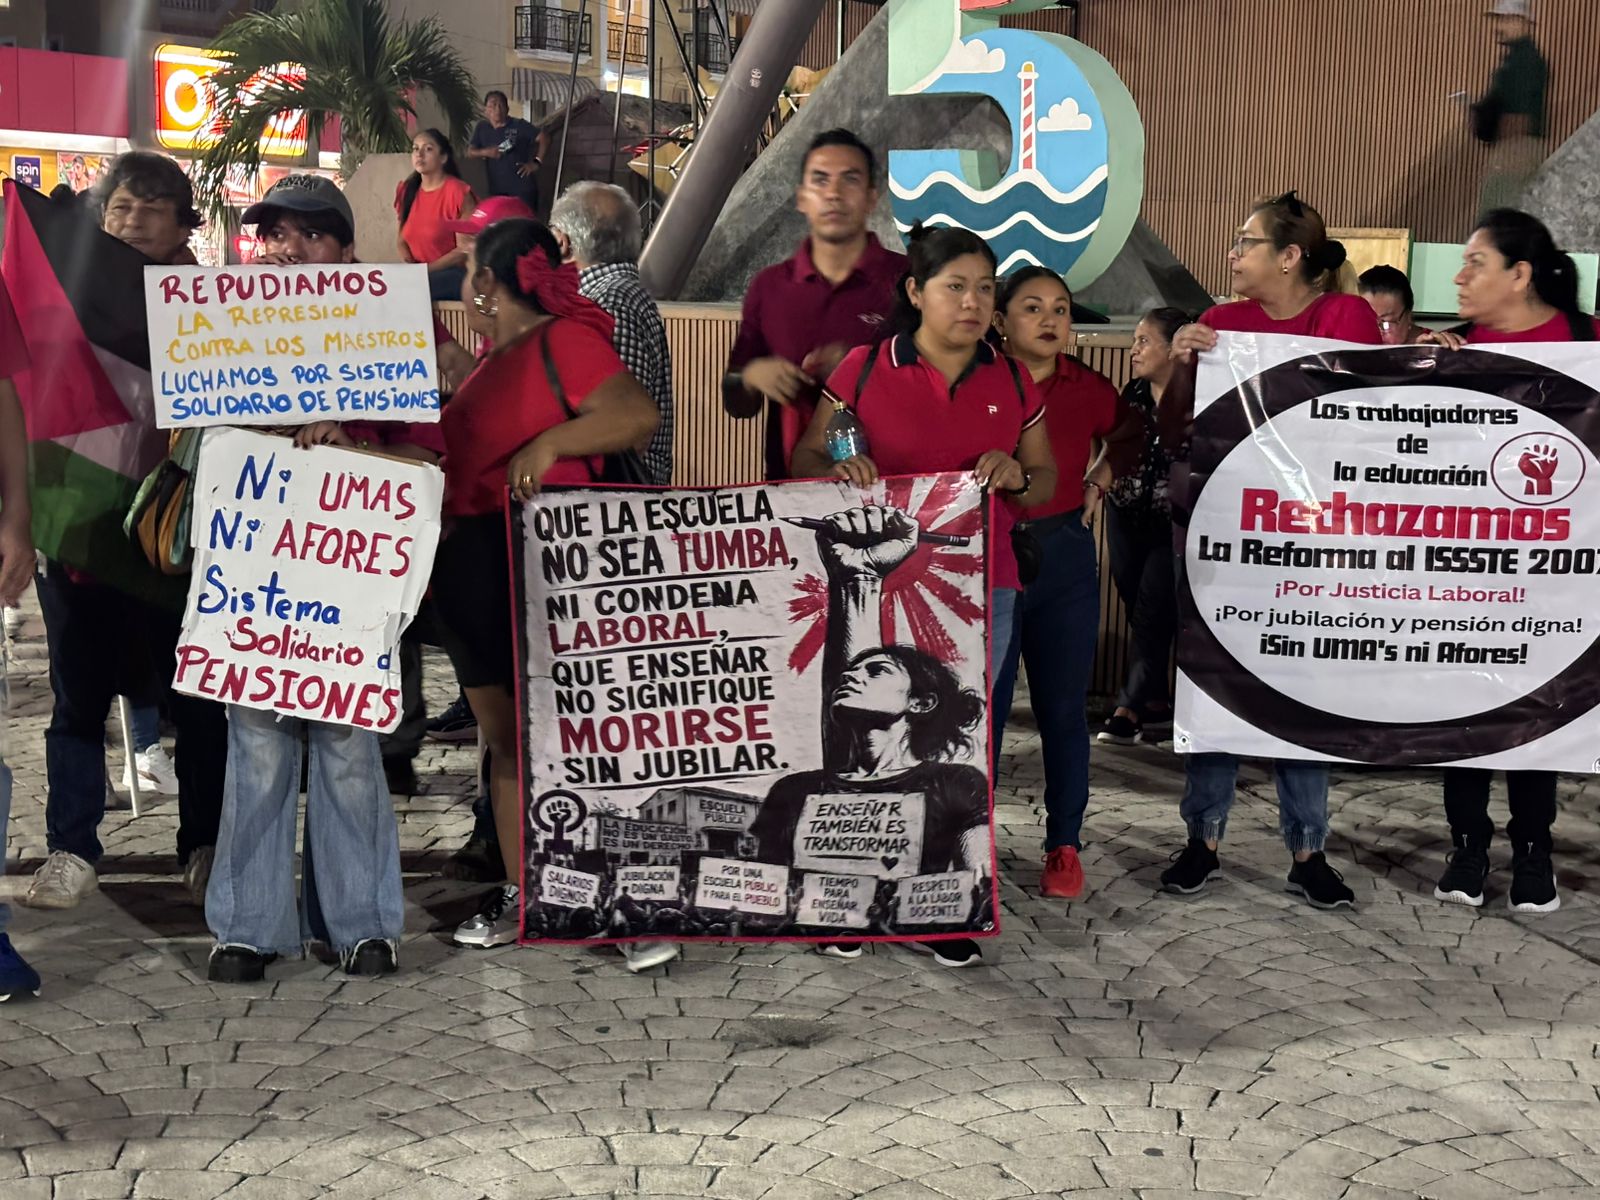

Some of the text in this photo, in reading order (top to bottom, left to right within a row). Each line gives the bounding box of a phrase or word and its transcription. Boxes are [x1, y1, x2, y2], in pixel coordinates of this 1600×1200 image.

[16, 162, 39, 177] spin
[159, 269, 388, 304] REPUDIAMOS
[177, 303, 359, 336] LA REPRESION
[167, 330, 428, 364] CONTRA LOS MAESTROS
[161, 359, 428, 396] LUCHAMOS POR SISTEMA
[171, 392, 293, 420] SOLIDARIO
[298, 390, 331, 413] DE
[1310, 399, 1519, 428] Los trabajadores
[1396, 433, 1428, 454] de
[1333, 461, 1487, 486] la educación
[319, 472, 416, 520] UMAS
[534, 489, 774, 542] QUE LA ESCUELA
[1240, 487, 1571, 541] Rechazamos
[272, 519, 414, 577] AFORES
[541, 526, 799, 584] NO SEA TUMBA,
[1198, 535, 1232, 563] La
[1240, 538, 1376, 570] Reforma
[1386, 545, 1415, 571] al
[1425, 545, 1519, 574] ISSSTE
[197, 564, 341, 625] Sistema
[545, 579, 759, 621] NI CONDENA
[1275, 580, 1526, 603] ¡Por Justicia Laboral!
[549, 611, 729, 654] LABORAL,
[1215, 605, 1582, 637] ¡Por jubilación y pensión digna!
[225, 616, 364, 666] Solidario
[1405, 641, 1430, 663] ni
[1436, 641, 1528, 664] Afores!
[552, 644, 769, 688] QUE ENSEÑAR
[175, 645, 400, 728] PENSIONES
[555, 675, 775, 715] NO SIGNIFIQUE
[559, 704, 773, 755] MORIRSE
[564, 743, 789, 783] SIN JUBILAR.
[700, 799, 746, 814] ESCUELA
[815, 800, 902, 817] ENSEÑAR
[603, 819, 620, 829] LA
[603, 828, 620, 838] NO
[624, 830, 638, 840] ES
[642, 832, 657, 841] UN
[809, 816, 907, 834] TAMBIÉN ES
[603, 838, 691, 850] ES UN DERECHO
[803, 836, 910, 855] TRANSFORMAR
[547, 870, 595, 891] SALARIOS
[703, 876, 741, 889] ESCUELA
[721, 865, 763, 879] POR UNA
[818, 876, 859, 889] TIEMPO
[911, 878, 960, 892] RESPETO
[703, 890, 709, 898] Y
[710, 890, 730, 900] PARA
[732, 892, 742, 901] EL
[823, 888, 850, 899] PARA
[907, 892, 963, 905] A LA LABOR
[818, 911, 847, 924] VIDA
